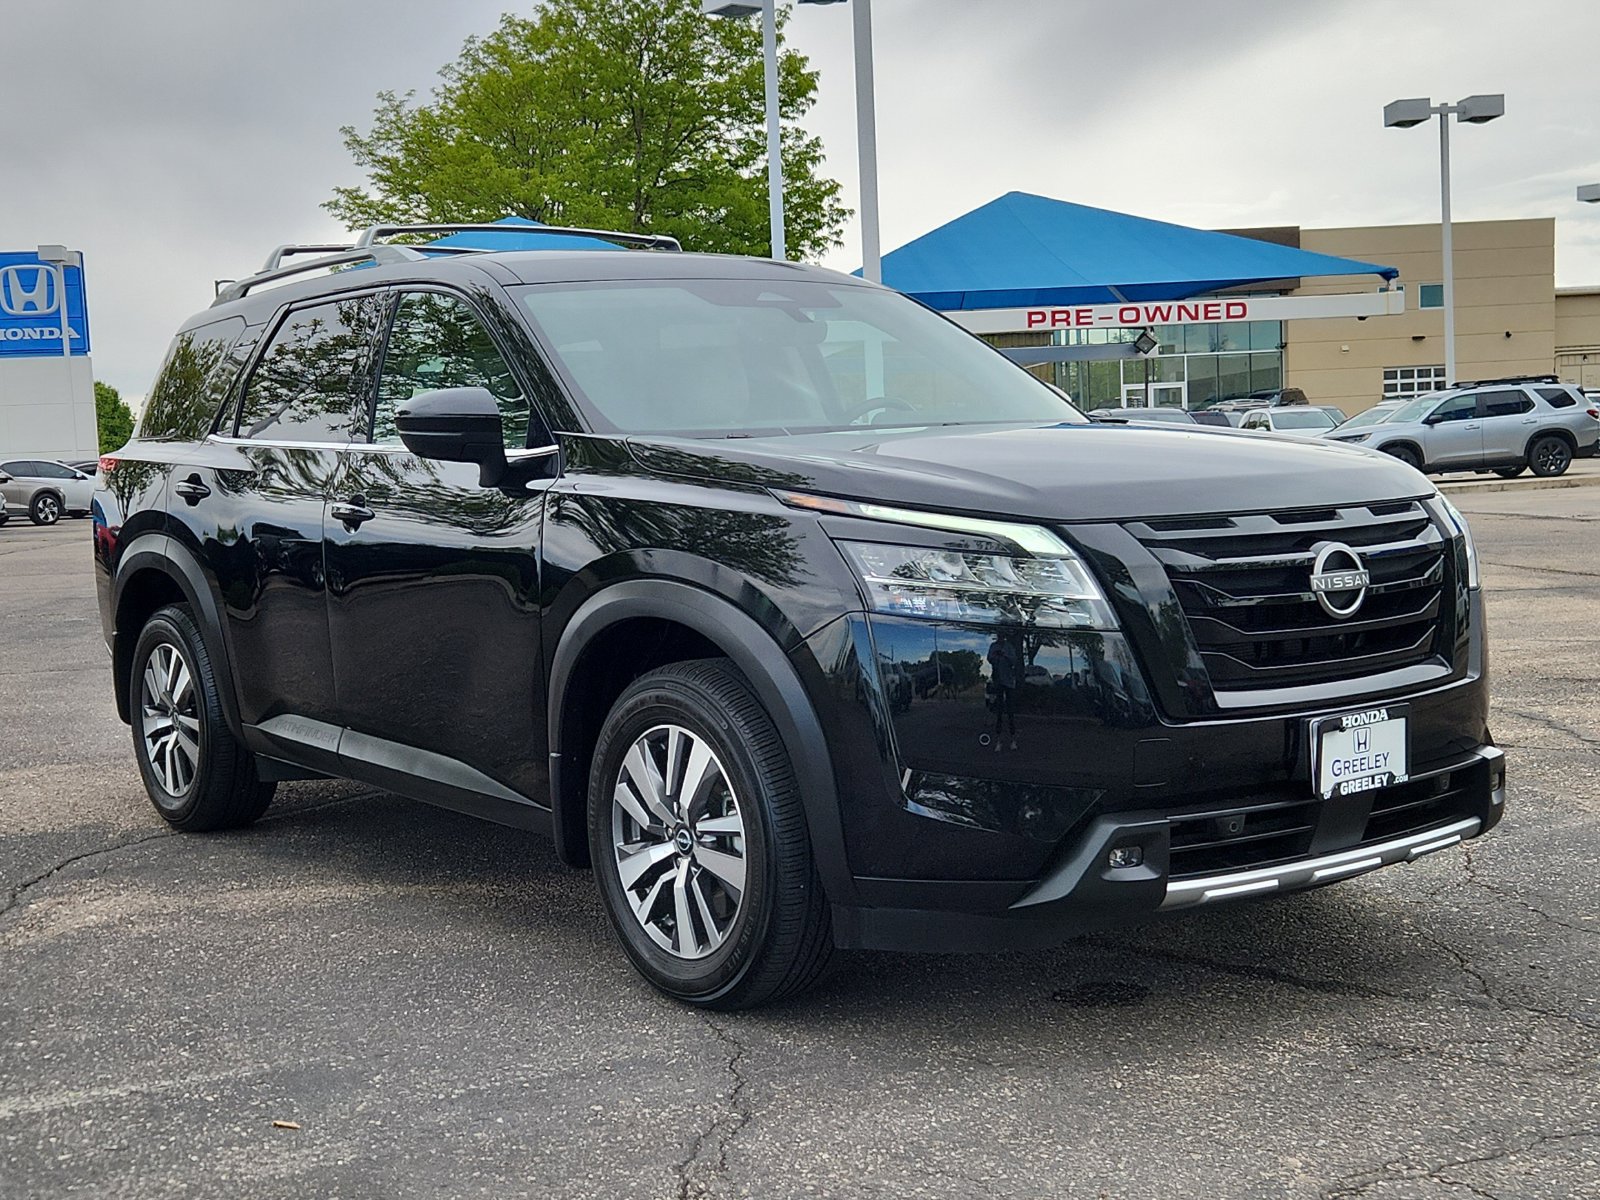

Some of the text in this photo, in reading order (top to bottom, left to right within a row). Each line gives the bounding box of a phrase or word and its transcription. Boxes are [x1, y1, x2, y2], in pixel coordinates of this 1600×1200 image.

[1027, 302, 1247, 328] PRE-OWNED
[1313, 573, 1370, 590] NISSAN
[1341, 708, 1389, 728] HONDA
[1331, 752, 1390, 777] GREELEY
[1340, 773, 1389, 796] GREELEY
